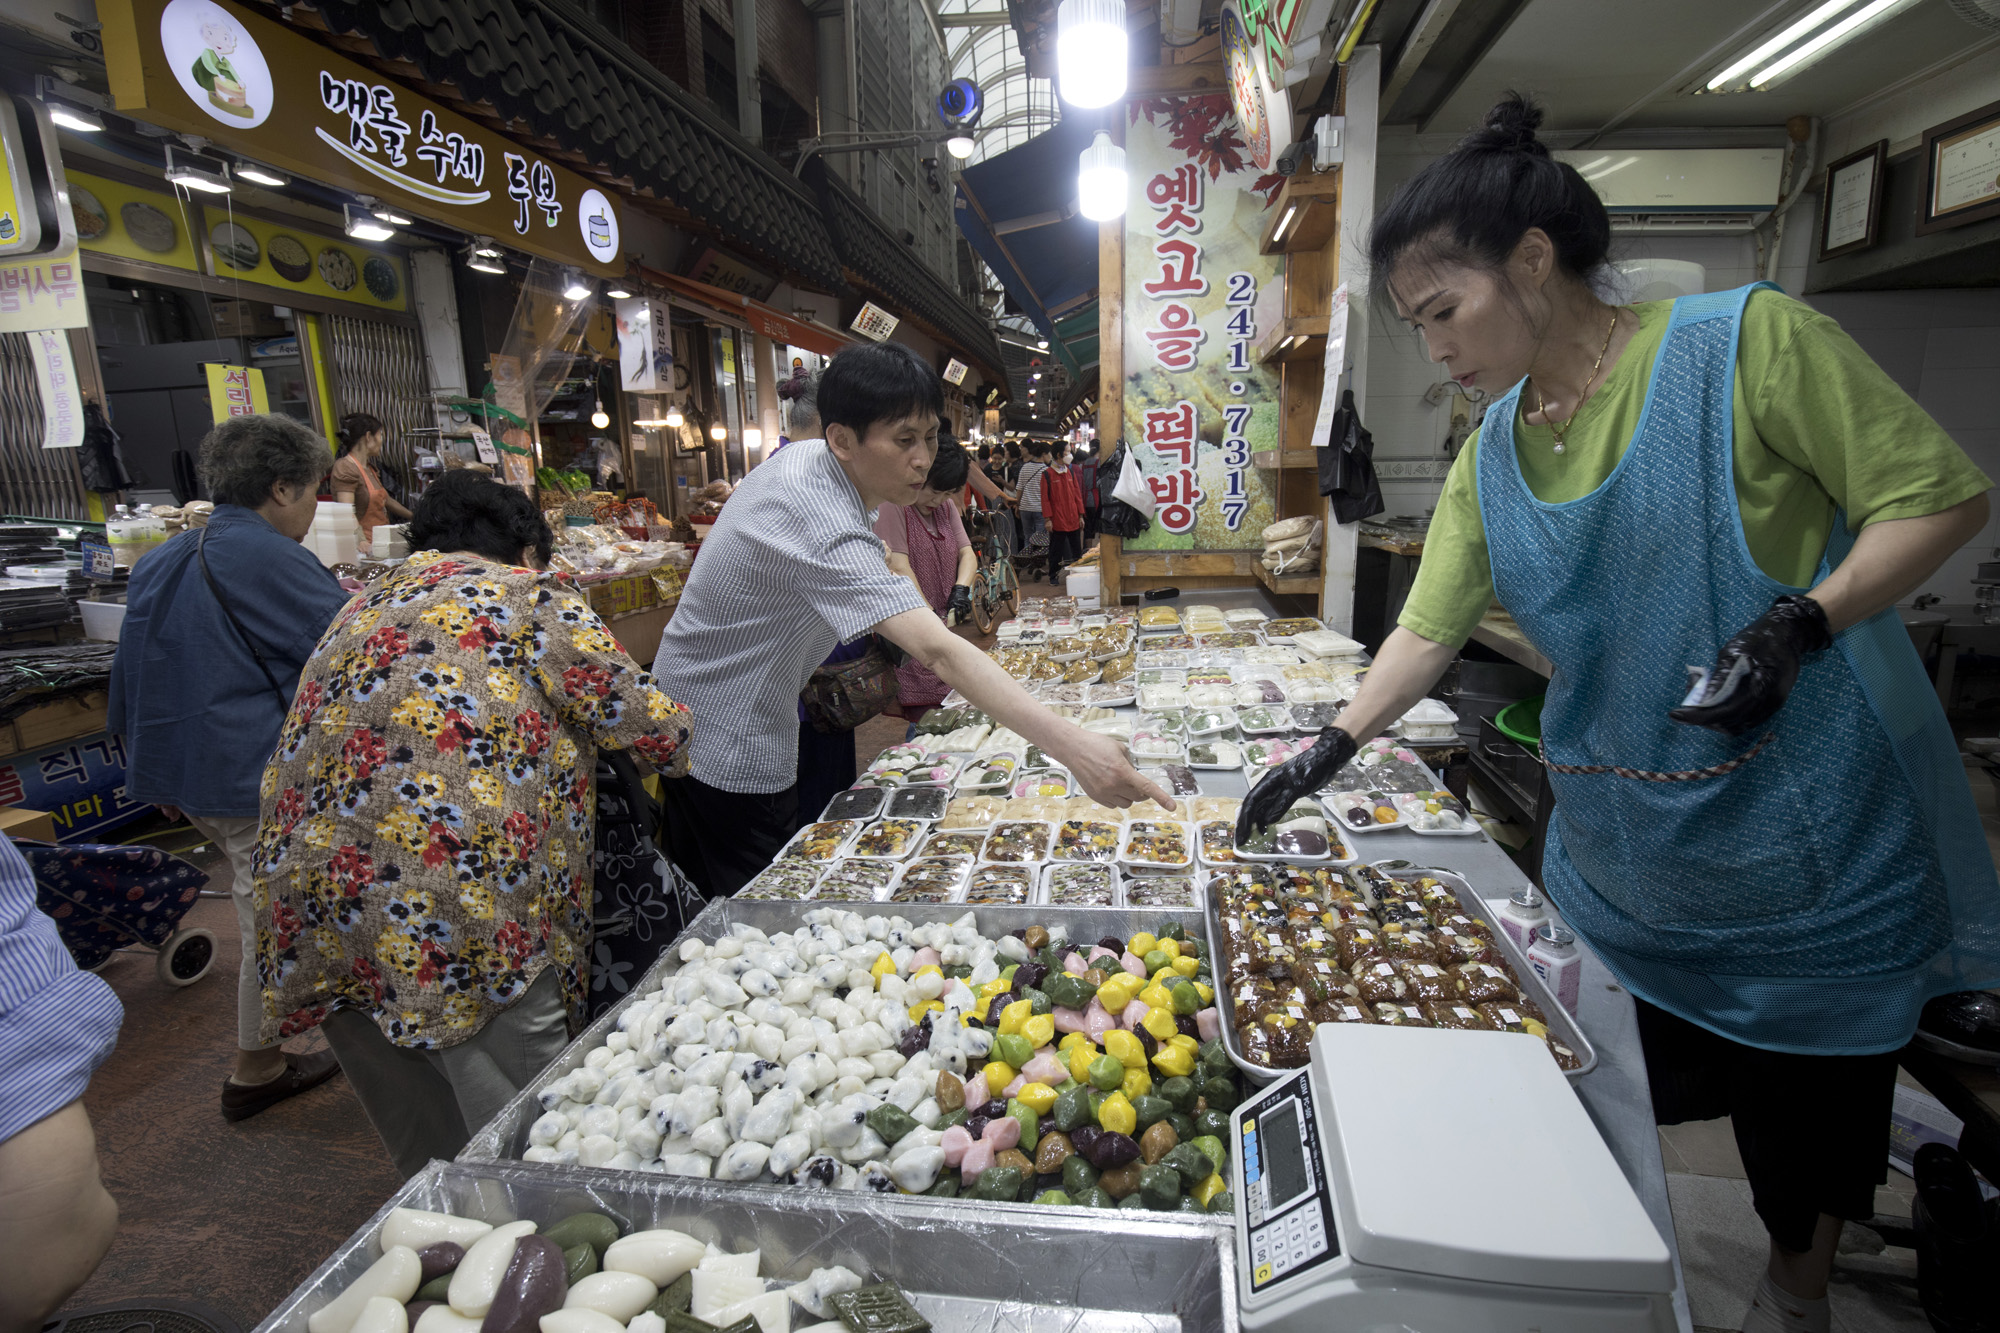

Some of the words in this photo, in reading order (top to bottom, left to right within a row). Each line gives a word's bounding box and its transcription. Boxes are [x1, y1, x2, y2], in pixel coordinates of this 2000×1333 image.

[320, 70, 411, 167] 맷돌
[416, 110, 484, 187] 수제
[504, 152, 562, 234] 두부
[1143, 162, 1206, 369] 옛고을
[655, 309, 669, 382] 금산인삼
[1145, 402, 1202, 531] 떡방
[38, 733, 127, 784] 직거
[50, 794, 103, 828] 시마
[1257, 1249, 1266, 1262] 00
[1258, 1269, 1268, 1279] C
